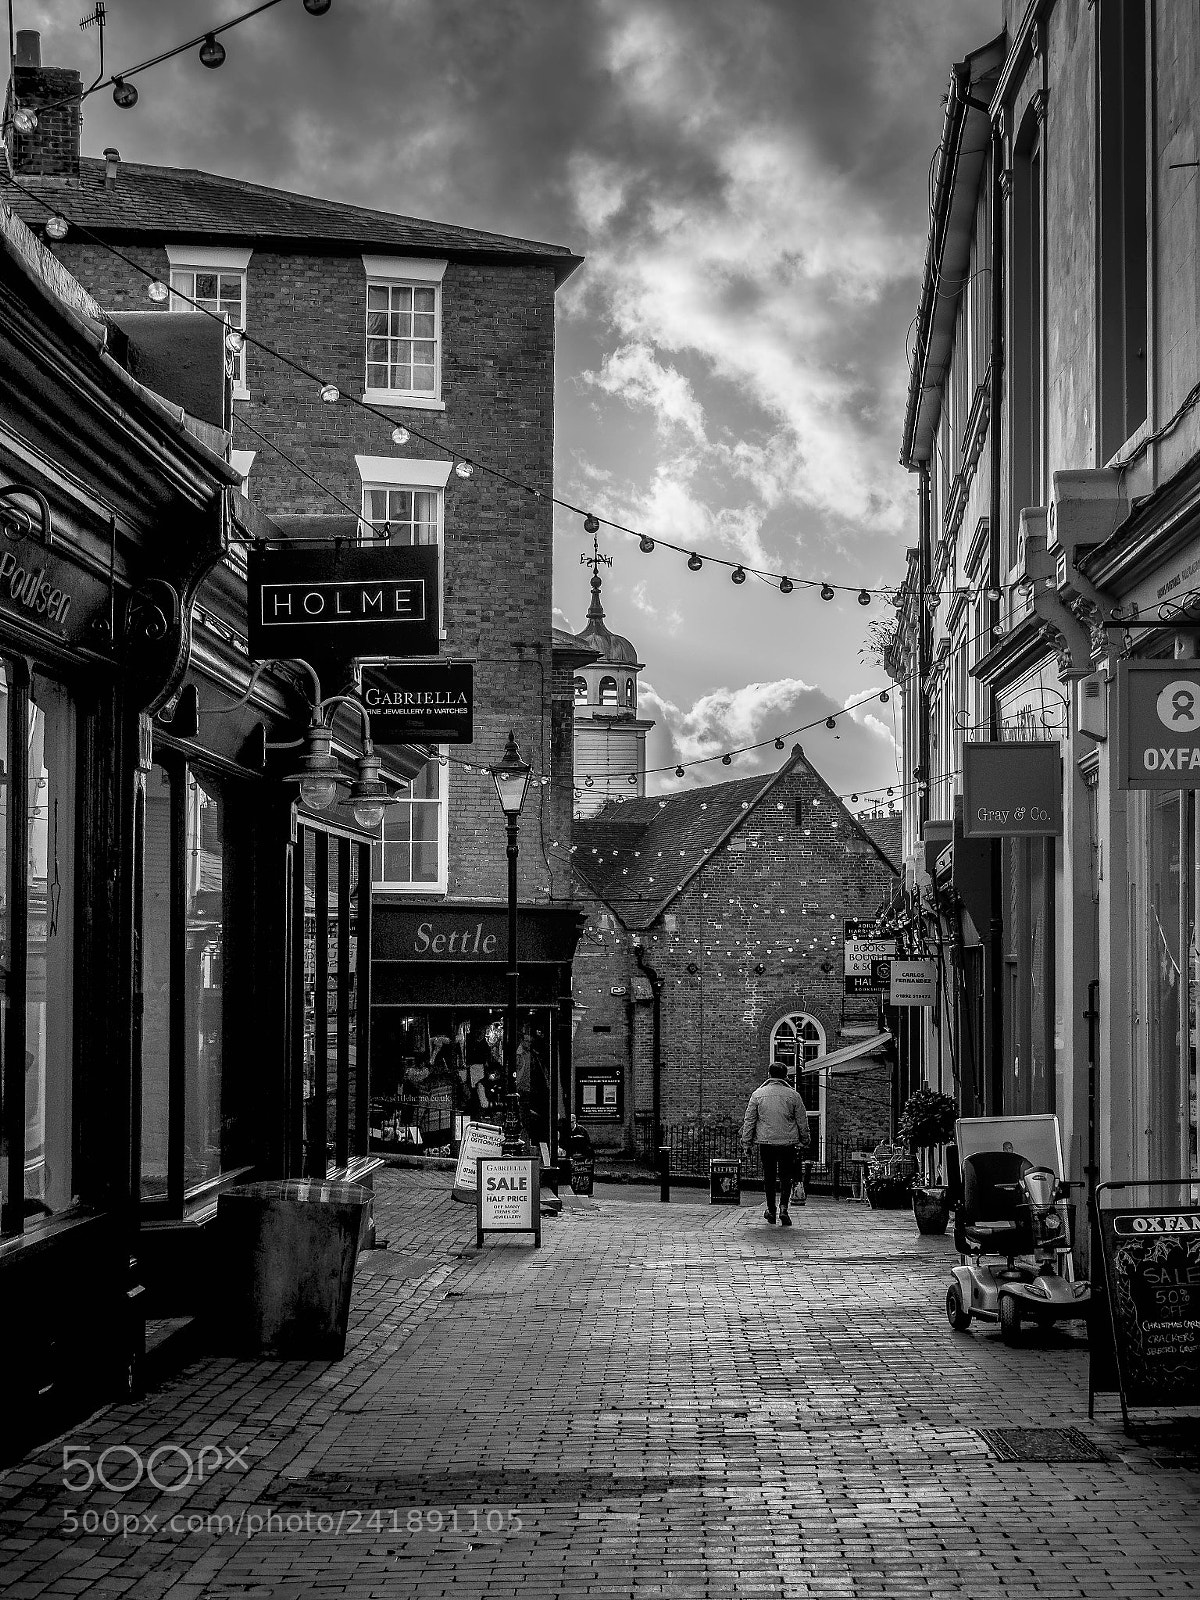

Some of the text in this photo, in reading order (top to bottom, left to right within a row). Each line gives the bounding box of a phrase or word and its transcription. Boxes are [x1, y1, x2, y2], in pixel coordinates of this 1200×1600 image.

[274, 589, 411, 616] HOLME
[365, 689, 468, 705] GABRIELLA
[977, 806, 1051, 824] Gray & Co.
[414, 922, 497, 953] Settle
[853, 944, 886, 952] BOOKS
[853, 963, 860, 971] &
[486, 1176, 528, 1191] SALE
[486, 1195, 506, 1203] HALF
[1143, 1266, 1200, 1285] SALE
[1156, 1290, 1190, 1304] 50%
[1160, 1303, 1189, 1318] OFF
